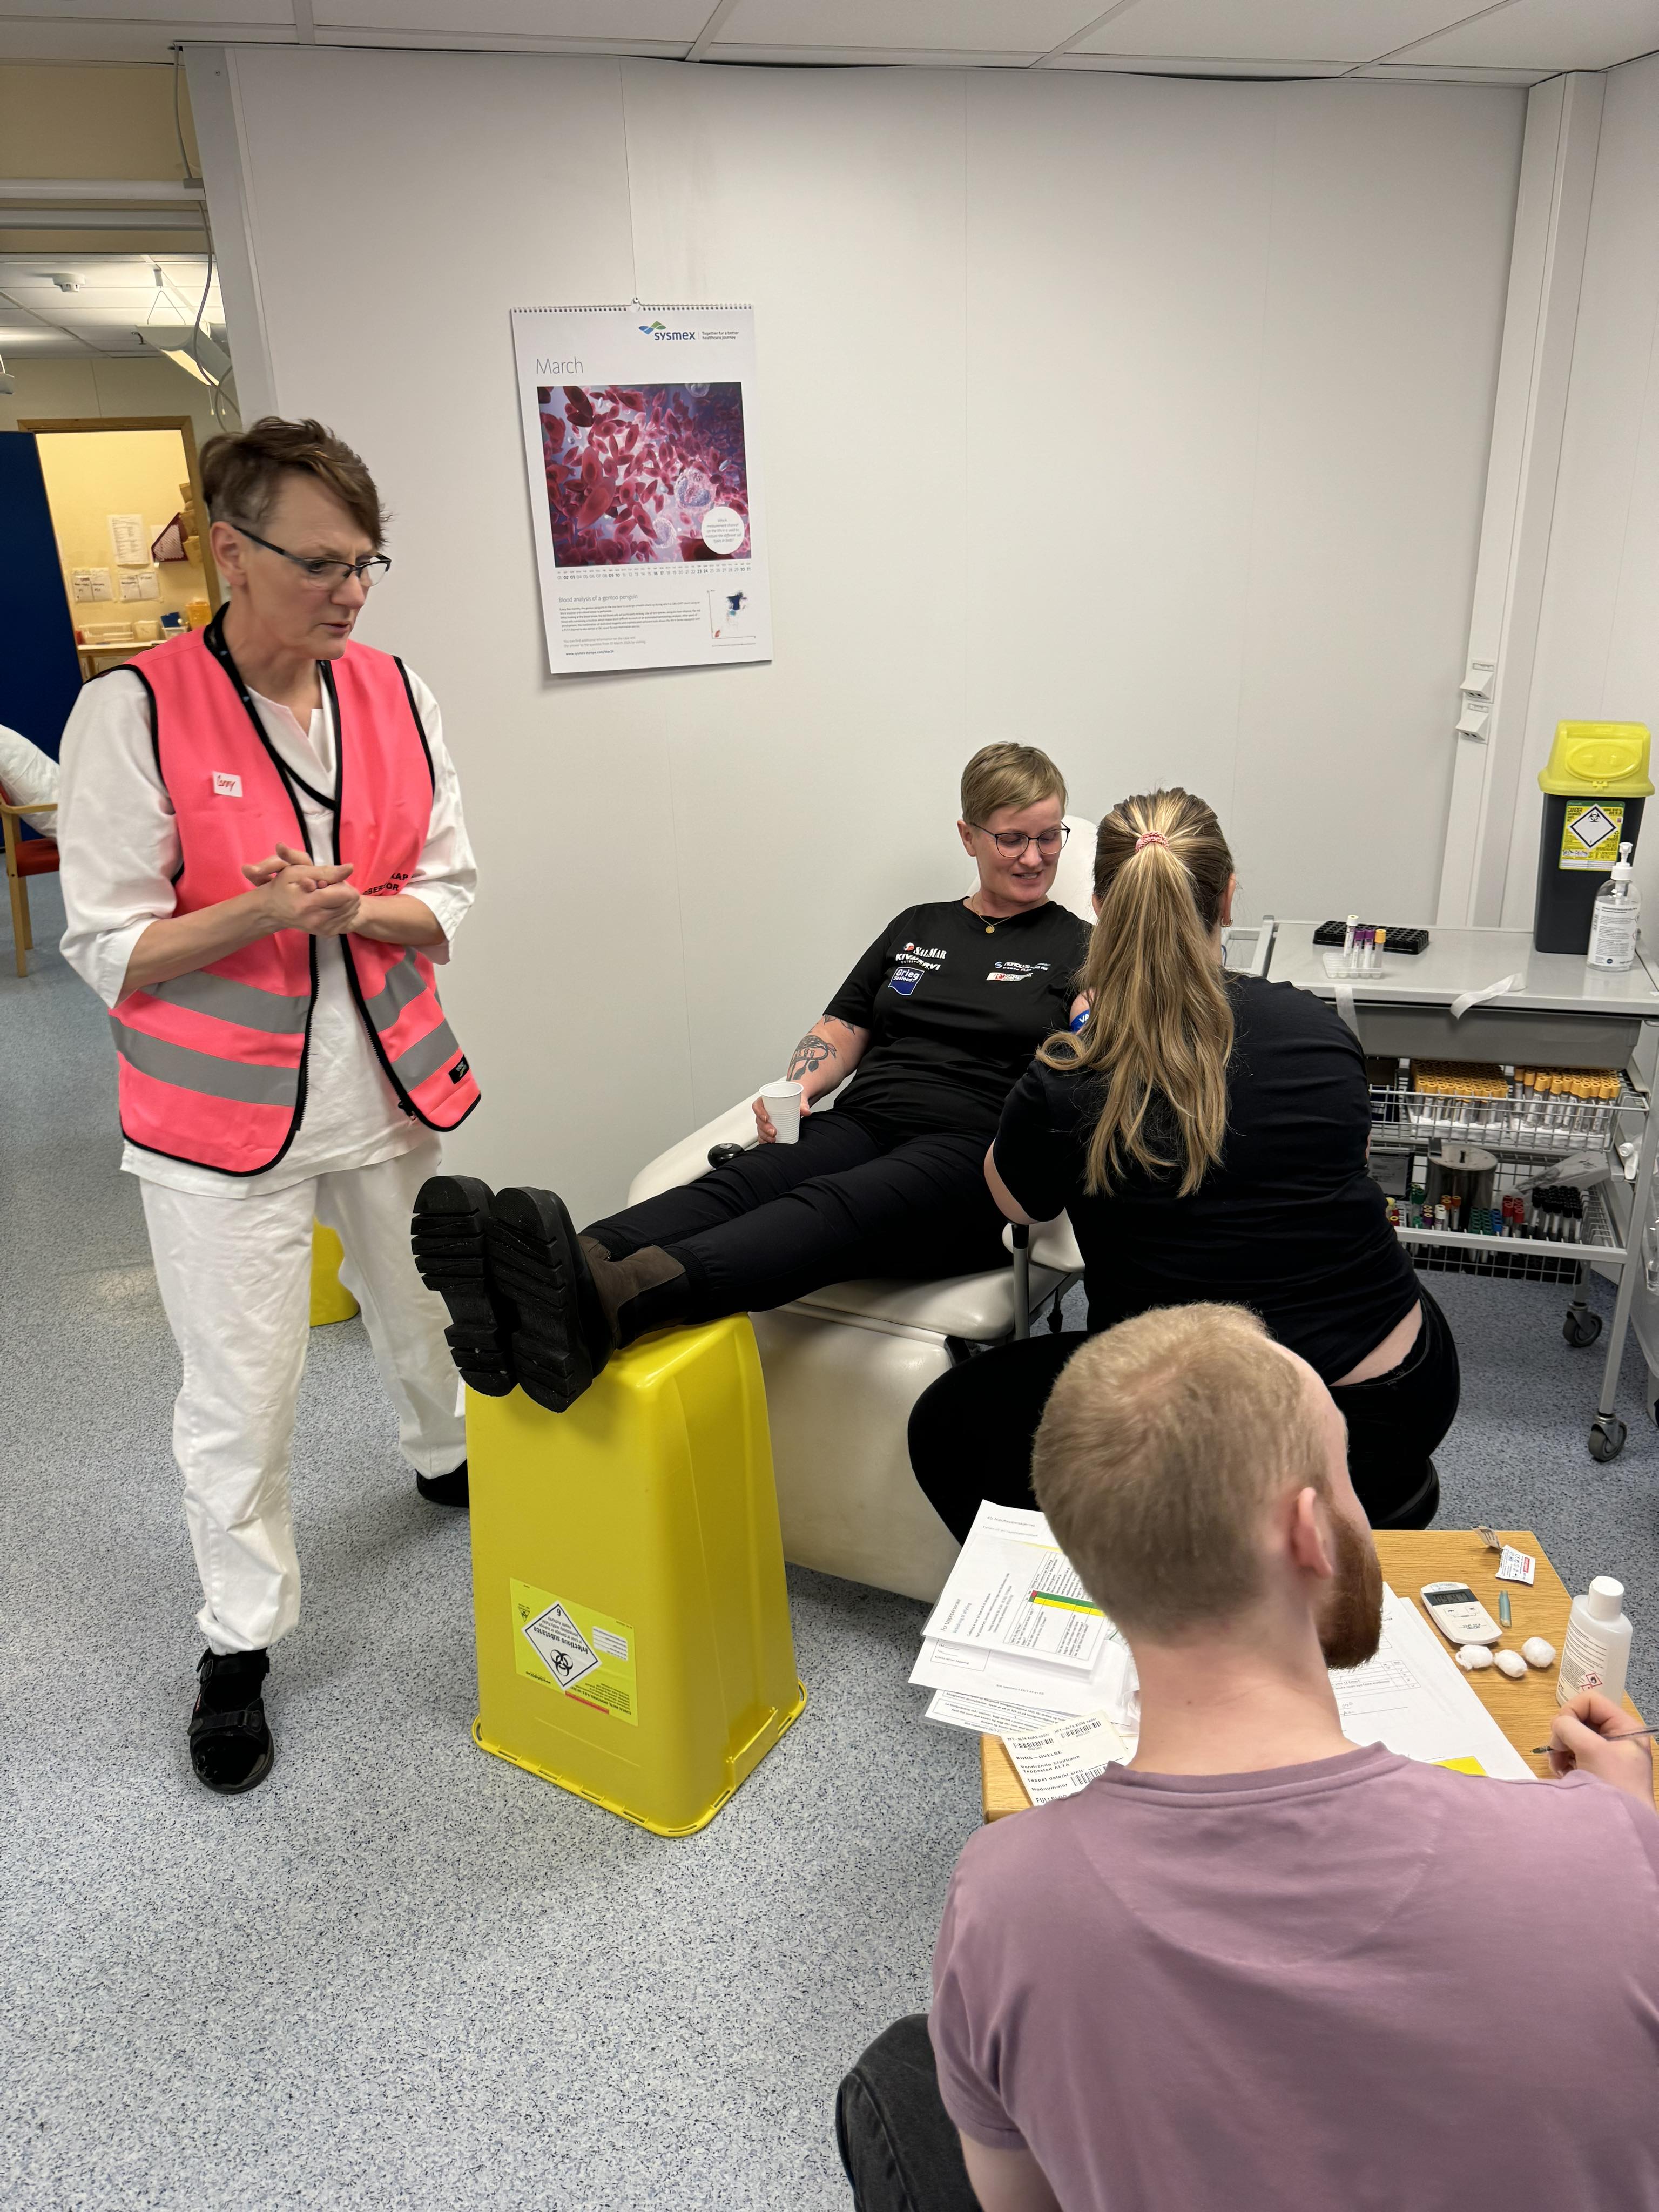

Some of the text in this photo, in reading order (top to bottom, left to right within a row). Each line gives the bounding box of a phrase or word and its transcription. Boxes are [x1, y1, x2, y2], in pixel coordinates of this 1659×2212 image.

[655, 331, 695, 341] sysmex
[536, 356, 583, 374] March
[896, 969, 920, 981] Grieg
[557, 1608, 561, 1616] 6
[533, 1626, 559, 1642] substance
[561, 1637, 588, 1655] Infectious
[1053, 1755, 1080, 1765] blodbank
